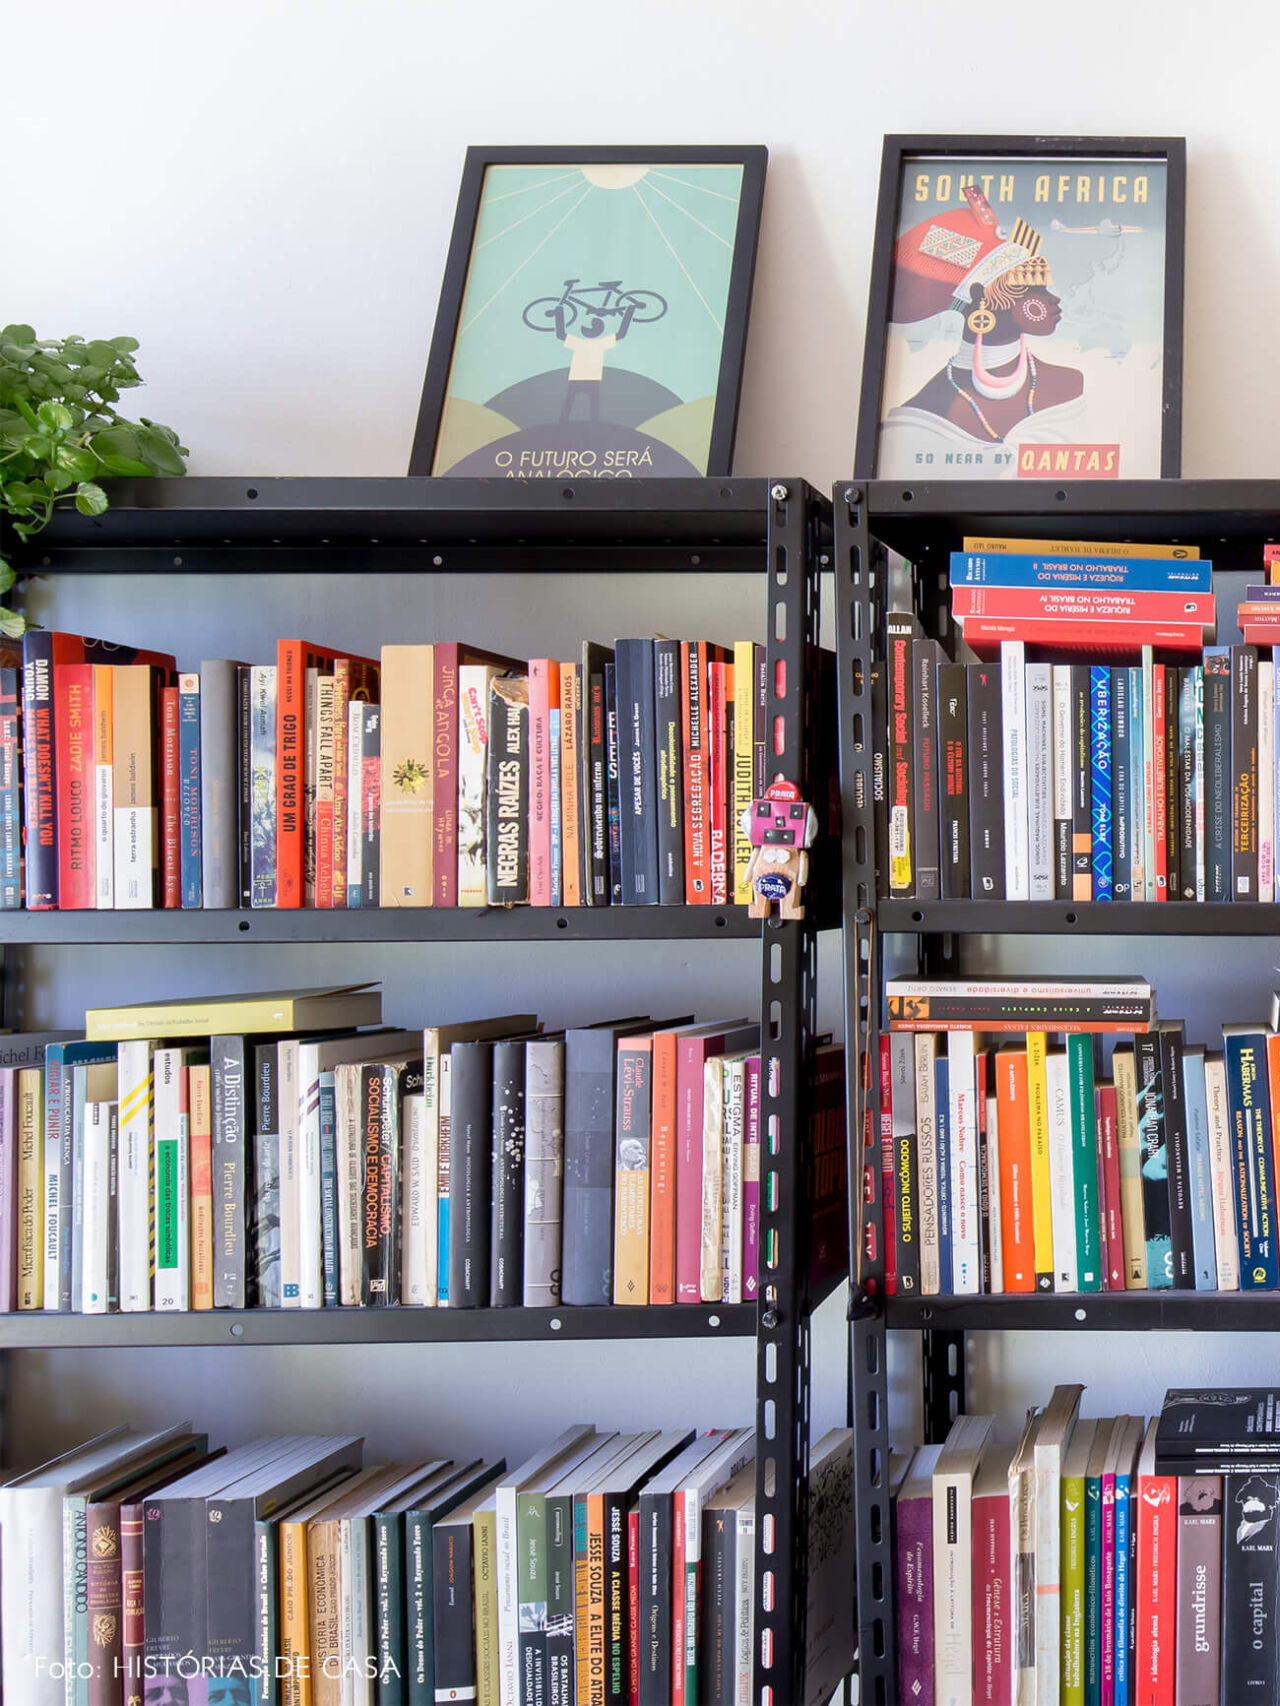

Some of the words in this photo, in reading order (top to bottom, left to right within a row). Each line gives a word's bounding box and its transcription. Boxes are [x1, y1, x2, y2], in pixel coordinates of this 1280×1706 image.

[915, 174, 1016, 203] SOUTH
[1035, 175, 1148, 204] AFRICA
[495, 451, 513, 467] O
[519, 450, 597, 467] FUTURO
[603, 446, 653, 467] SERÁ
[916, 453, 934, 465] SO
[945, 453, 983, 465] NEAR
[994, 453, 1013, 465] BY
[1021, 450, 1115, 471] QANTAS
[35, 659, 49, 701] DAMON
[562, 675, 573, 709] RAMOS
[688, 653, 699, 701] ALEXANDER
[921, 658, 931, 690] Reinhart
[69, 684, 82, 728] SMITH
[319, 682, 334, 723] THINGS
[921, 692, 931, 728] Koselleck
[37, 708, 50, 741] WHAT
[283, 715, 297, 751] TRIGO
[319, 726, 334, 754] FALL
[506, 727, 520, 753] ALEX
[563, 711, 574, 750] LÁZARO
[689, 705, 700, 748] MICHELLE
[1096, 679, 1110, 770] UBERIZAÇÃO
[38, 743, 51, 794] DOESN'T
[69, 732, 82, 772] ZADIE
[166, 728, 176, 777] Morrison
[189, 748, 199, 778] TONI
[283, 754, 297, 770] DE
[1213, 724, 1224, 799] NEOLIBERALISMO
[319, 757, 334, 790] APART
[496, 760, 520, 818] RAÍZES
[688, 754, 704, 829] SEGREGAÇÃO
[736, 752, 751, 801] JUDITH
[874, 753, 884, 801] SOCIALISMO
[39, 795, 52, 821] KILL
[70, 780, 84, 823] LOUCO
[632, 787, 642, 815] APESAR
[1239, 773, 1252, 852] TERCEIRIZAÇÃO
[40, 823, 53, 846] YOU
[189, 785, 199, 857] MORRISON
[283, 813, 297, 832] UM
[1059, 822, 1068, 850] Maurizio
[70, 828, 84, 870] RITMO
[497, 822, 519, 887] NEGRAS
[691, 831, 704, 857] NOVA
[712, 829, 726, 904] BADERNA
[1059, 852, 1068, 886] Lazzarato
[48, 1061, 60, 1095] VIGIAR
[163, 1053, 173, 1085] estudos
[223, 1056, 241, 1070] A
[1240, 1048, 1255, 1107] HABERMAS
[622, 1057, 636, 1131] Lévi-Strauss
[731, 1074, 743, 1137] ESTIGMA
[749, 1072, 758, 1101] RITUAL
[22, 1092, 33, 1130] Foucault
[48, 1108, 60, 1140] PUNIR
[222, 1074, 242, 1143] Distinção
[367, 1077, 379, 1153] SOCIALISMO
[22, 1132, 33, 1161] Michel
[921, 1117, 933, 1163] RUSSOS
[224, 1162, 237, 1197] Pierre
[899, 1139, 911, 1194] INCÔMODO
[22, 1188, 33, 1215] Poder
[48, 1174, 58, 1209] MICHEL
[923, 1165, 936, 1246] PENSADORES
[223, 1203, 237, 1256] Bourdieu
[901, 1196, 912, 1232] SUJEITO
[22, 1229, 34, 1278] Microfísica
[48, 1213, 58, 1261] FOUCAULT
[74, 1510, 87, 1561] ANTONIO
[480, 1525, 490, 1547] IANNI
[610, 1507, 623, 1533] JESSÉ
[481, 1549, 490, 1581] OCTAVIO
[610, 1534, 622, 1563] SOUZA
[74, 1561, 87, 1614] CANDIDO
[316, 1554, 326, 1614] ECONÔMICA
[588, 1566, 602, 1605] SOUZA
[610, 1579, 621, 1609] CLASSE
[609, 1611, 622, 1641] MÉDIA
[1149, 1615, 1160, 1638] alemã
[1191, 1565, 1208, 1652] grundrisse
[1249, 1581, 1267, 1635] capital
[610, 1655, 621, 1694] ESPELHO
[1150, 1640, 1162, 1675] ideologia
